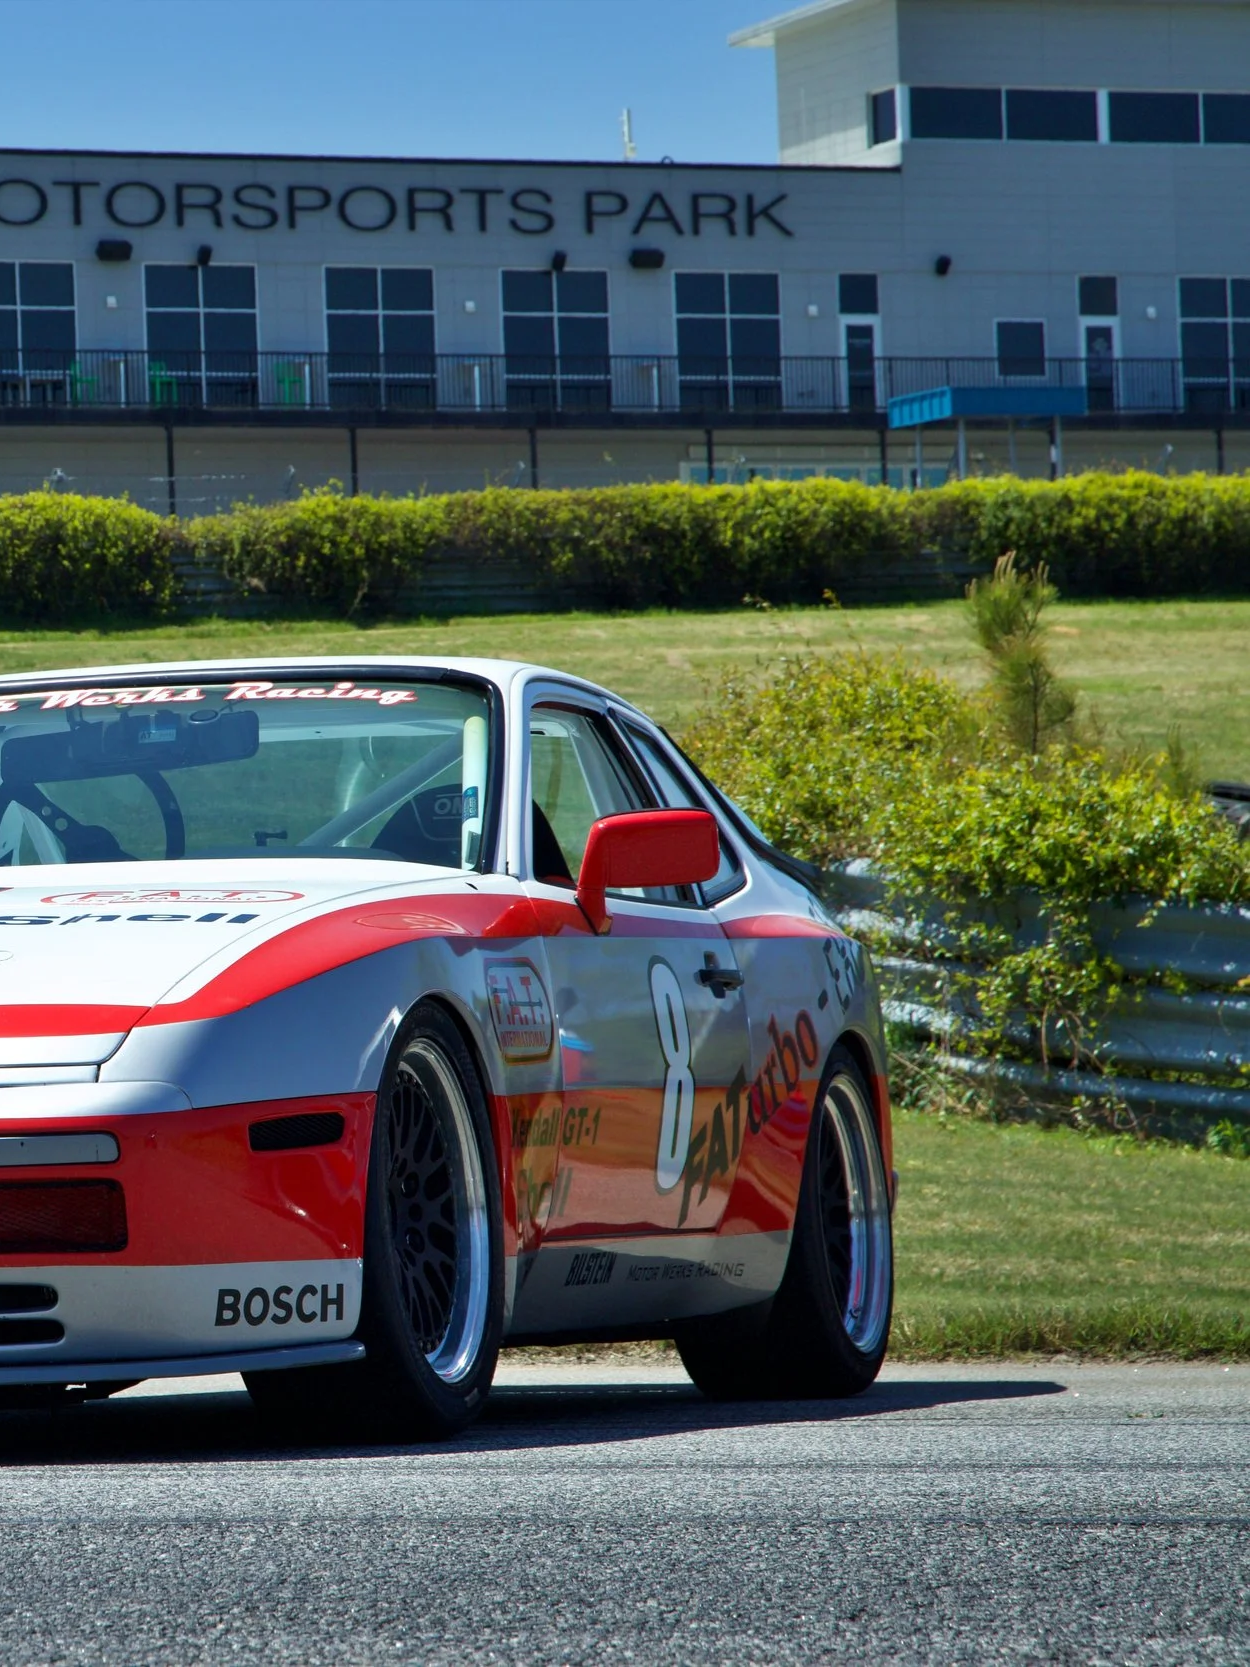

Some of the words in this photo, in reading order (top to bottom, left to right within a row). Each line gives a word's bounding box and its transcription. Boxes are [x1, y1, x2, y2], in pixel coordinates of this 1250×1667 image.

[584, 189, 795, 238] PARK
[40, 687, 206, 709] Werks
[223, 681, 419, 706] Racing
[648, 955, 695, 1195] 8
[562, 1106, 602, 1146] GT-1
[564, 1251, 618, 1287] BILSTEIN
[214, 1283, 344, 1327] BOSCH
